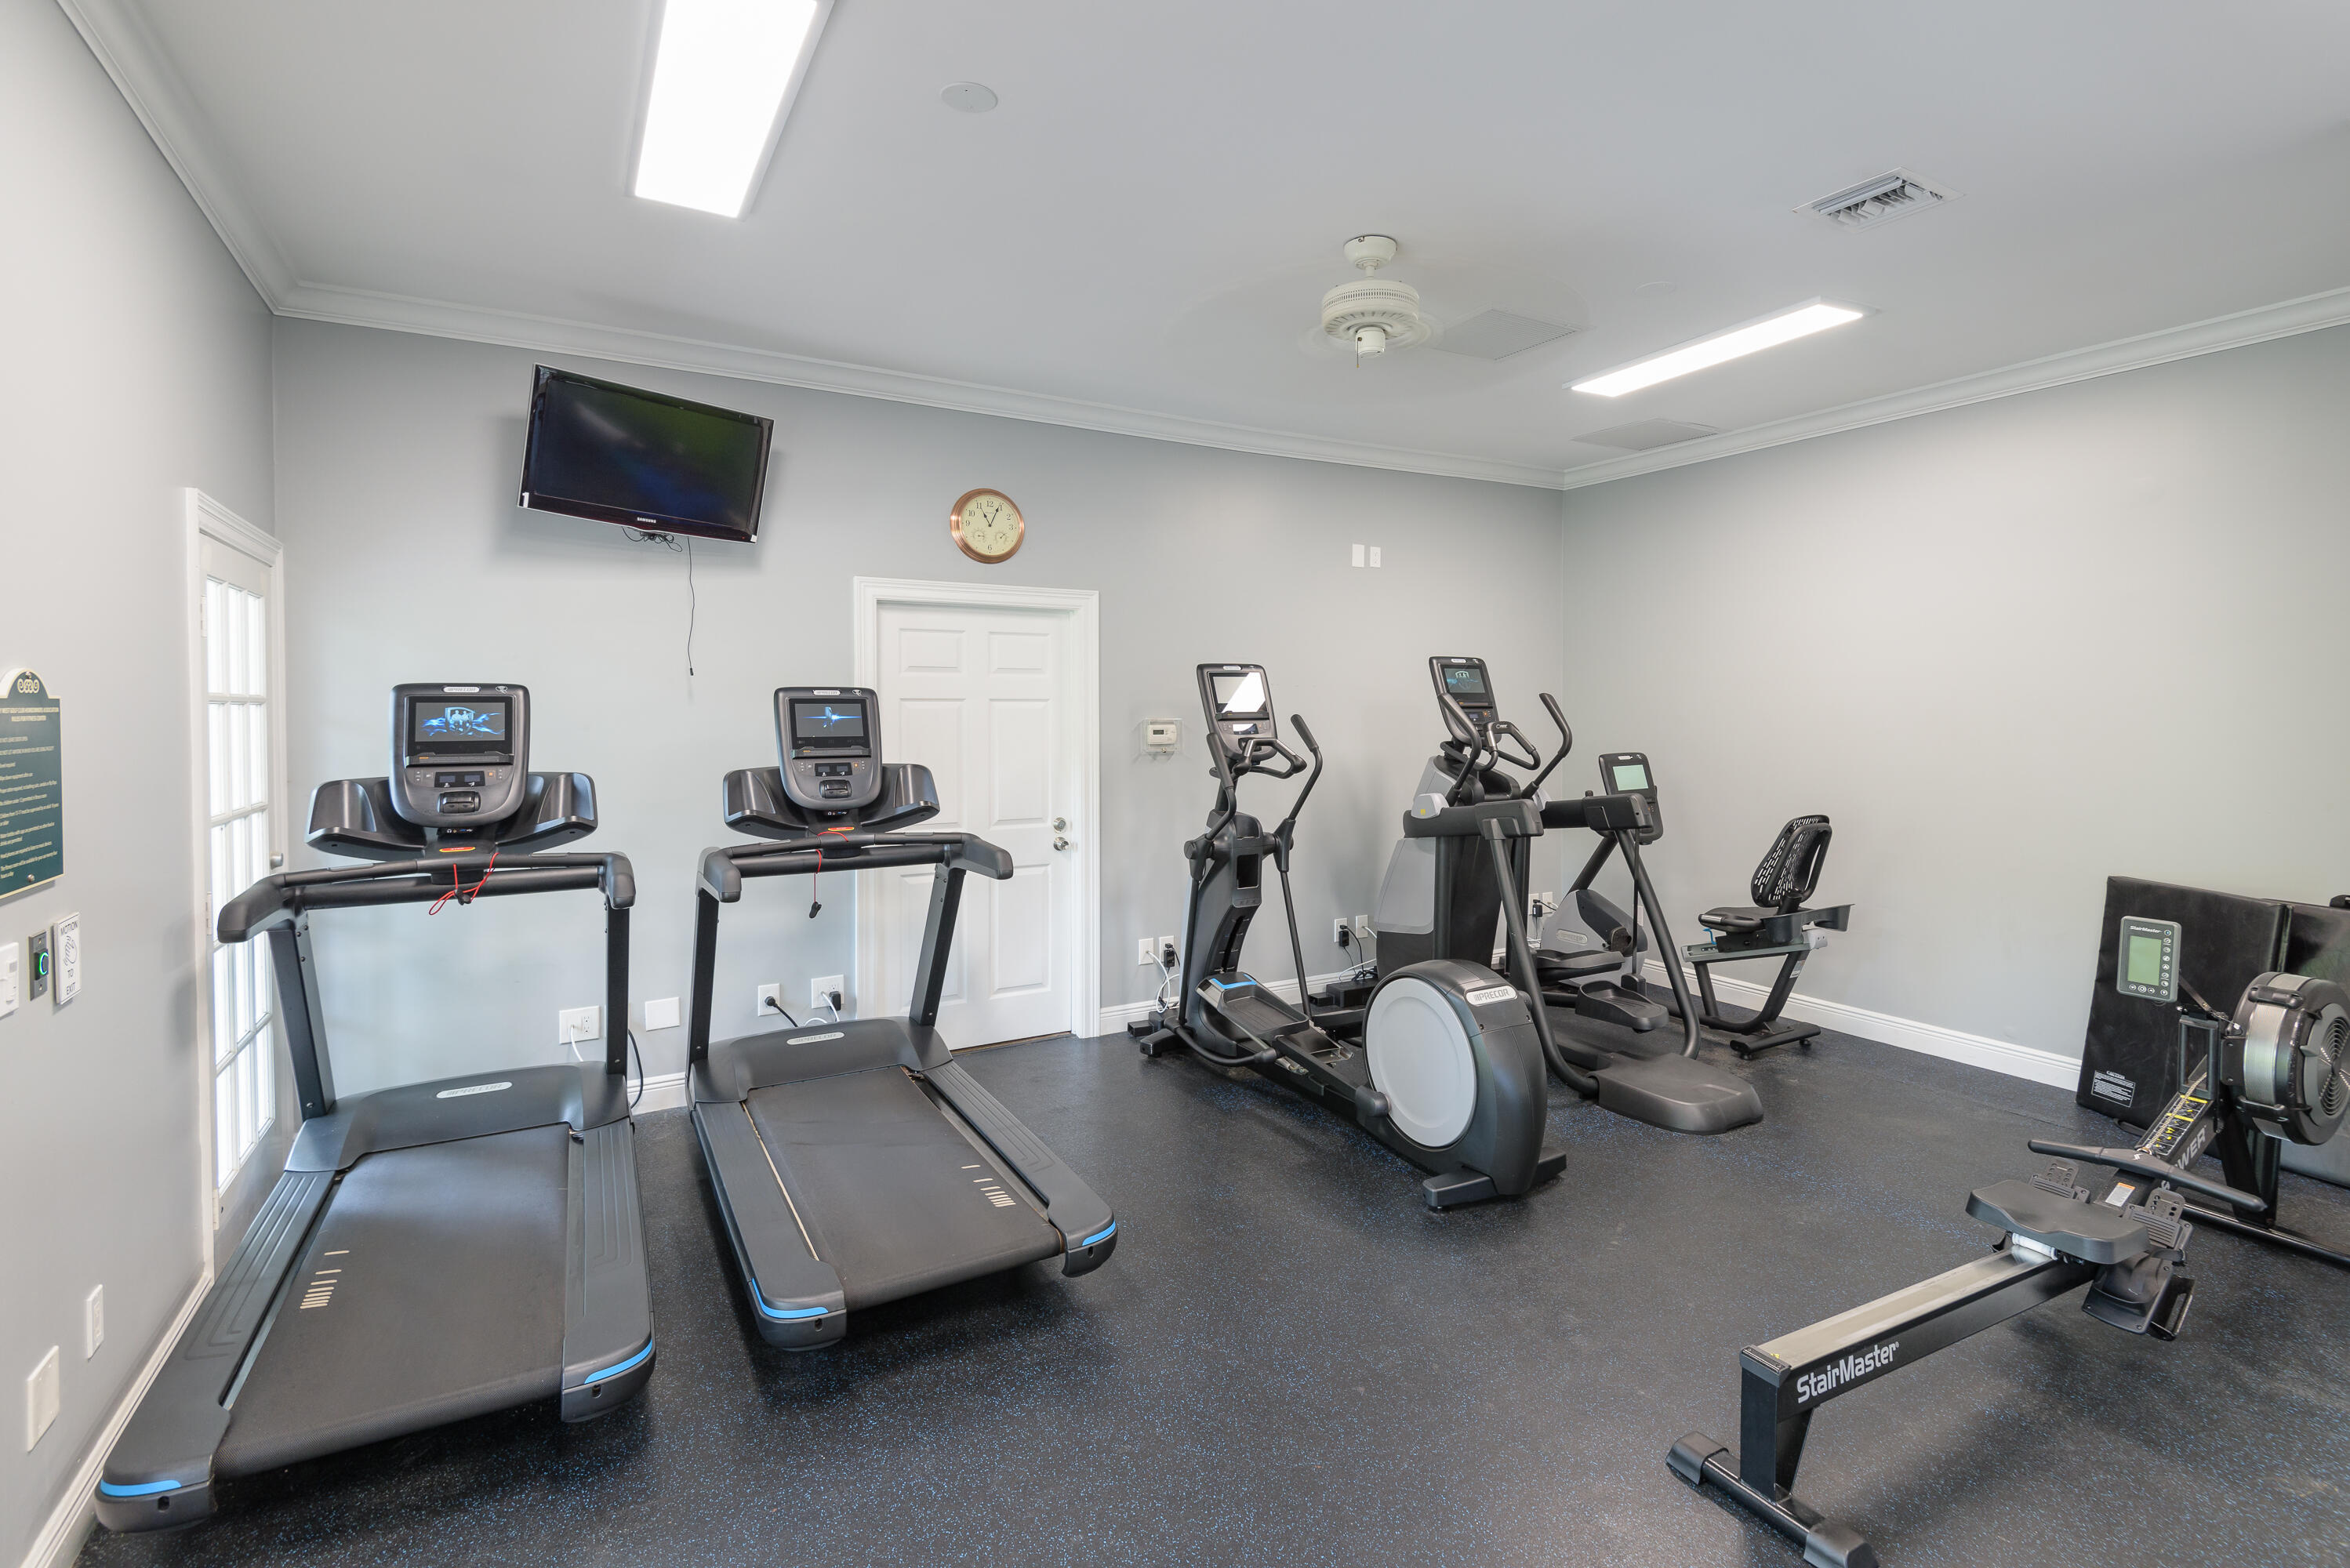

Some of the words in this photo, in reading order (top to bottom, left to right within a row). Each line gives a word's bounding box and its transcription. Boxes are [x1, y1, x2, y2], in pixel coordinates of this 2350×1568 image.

[60, 920, 78, 935] MOTION
[67, 968, 74, 979] TO
[66, 982, 76, 996] EXIT
[1476, 989, 1509, 1001] PRECOR
[1796, 1343, 1897, 1404] StairMaster
